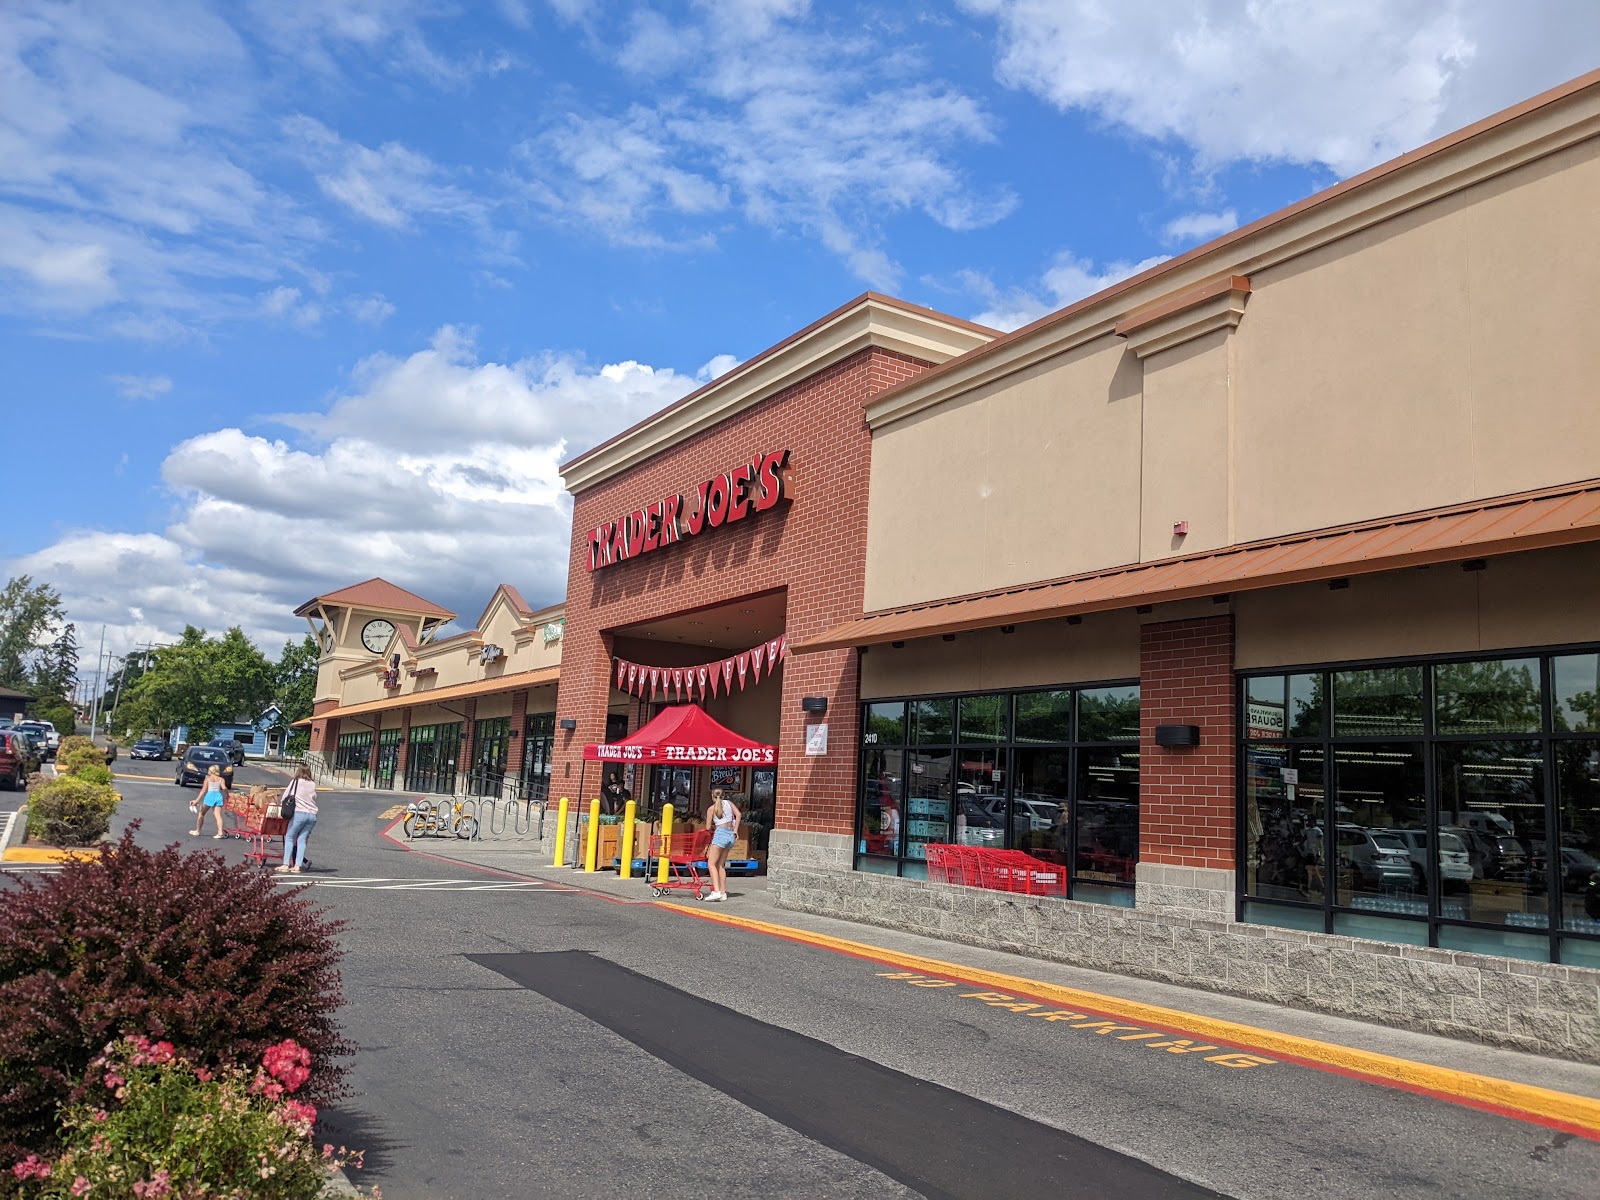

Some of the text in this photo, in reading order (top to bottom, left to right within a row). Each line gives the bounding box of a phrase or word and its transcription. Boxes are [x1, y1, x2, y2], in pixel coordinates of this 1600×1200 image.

[586, 450, 791, 572] TRADER JOE'S
[619, 661, 707, 688] FEARLESS
[864, 733, 878, 743] 2410
[597, 745, 622, 759] TRADER
[623, 745, 643, 759] JOE'S
[665, 746, 727, 761] TRADER
[731, 747, 775, 763] JOE'S
[875, 971, 1280, 1068] NO PARKING
